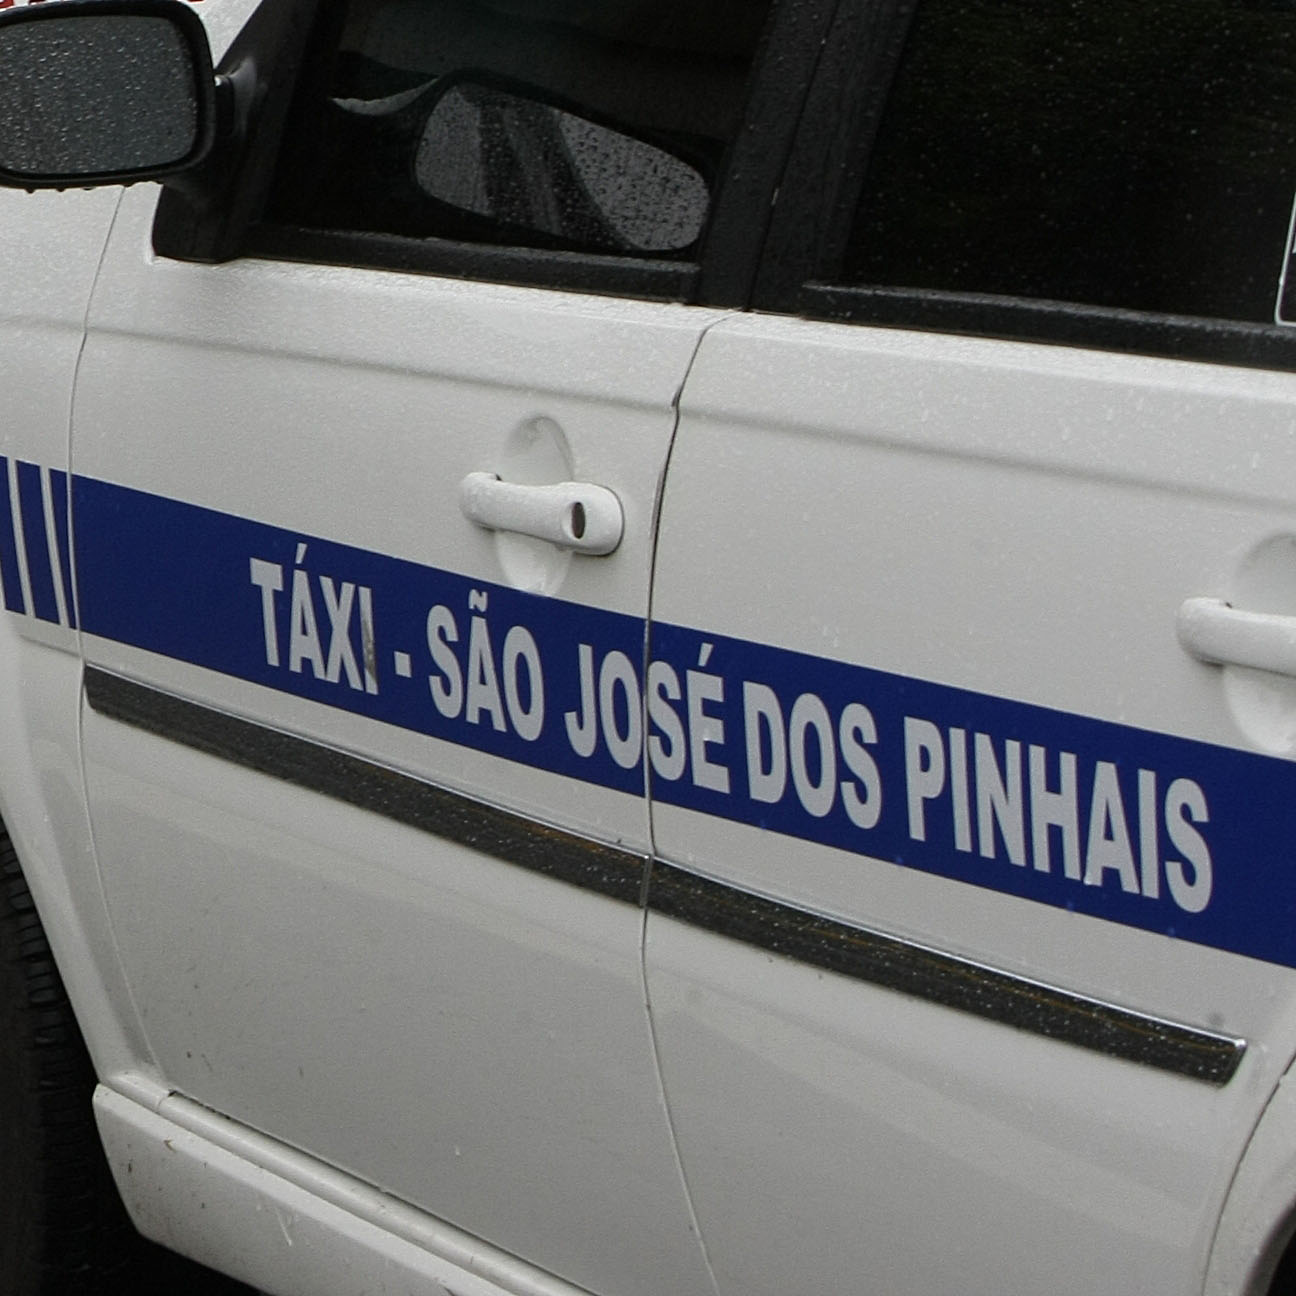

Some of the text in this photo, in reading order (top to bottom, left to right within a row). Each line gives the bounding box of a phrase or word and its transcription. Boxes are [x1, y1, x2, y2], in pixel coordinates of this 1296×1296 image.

[250, 542, 379, 696] TÁXI
[426, 589, 545, 742] SÃO
[564, 641, 730, 795] JOSÉ
[742, 680, 883, 830] DOS
[903, 715, 1213, 914] PINHAIS
